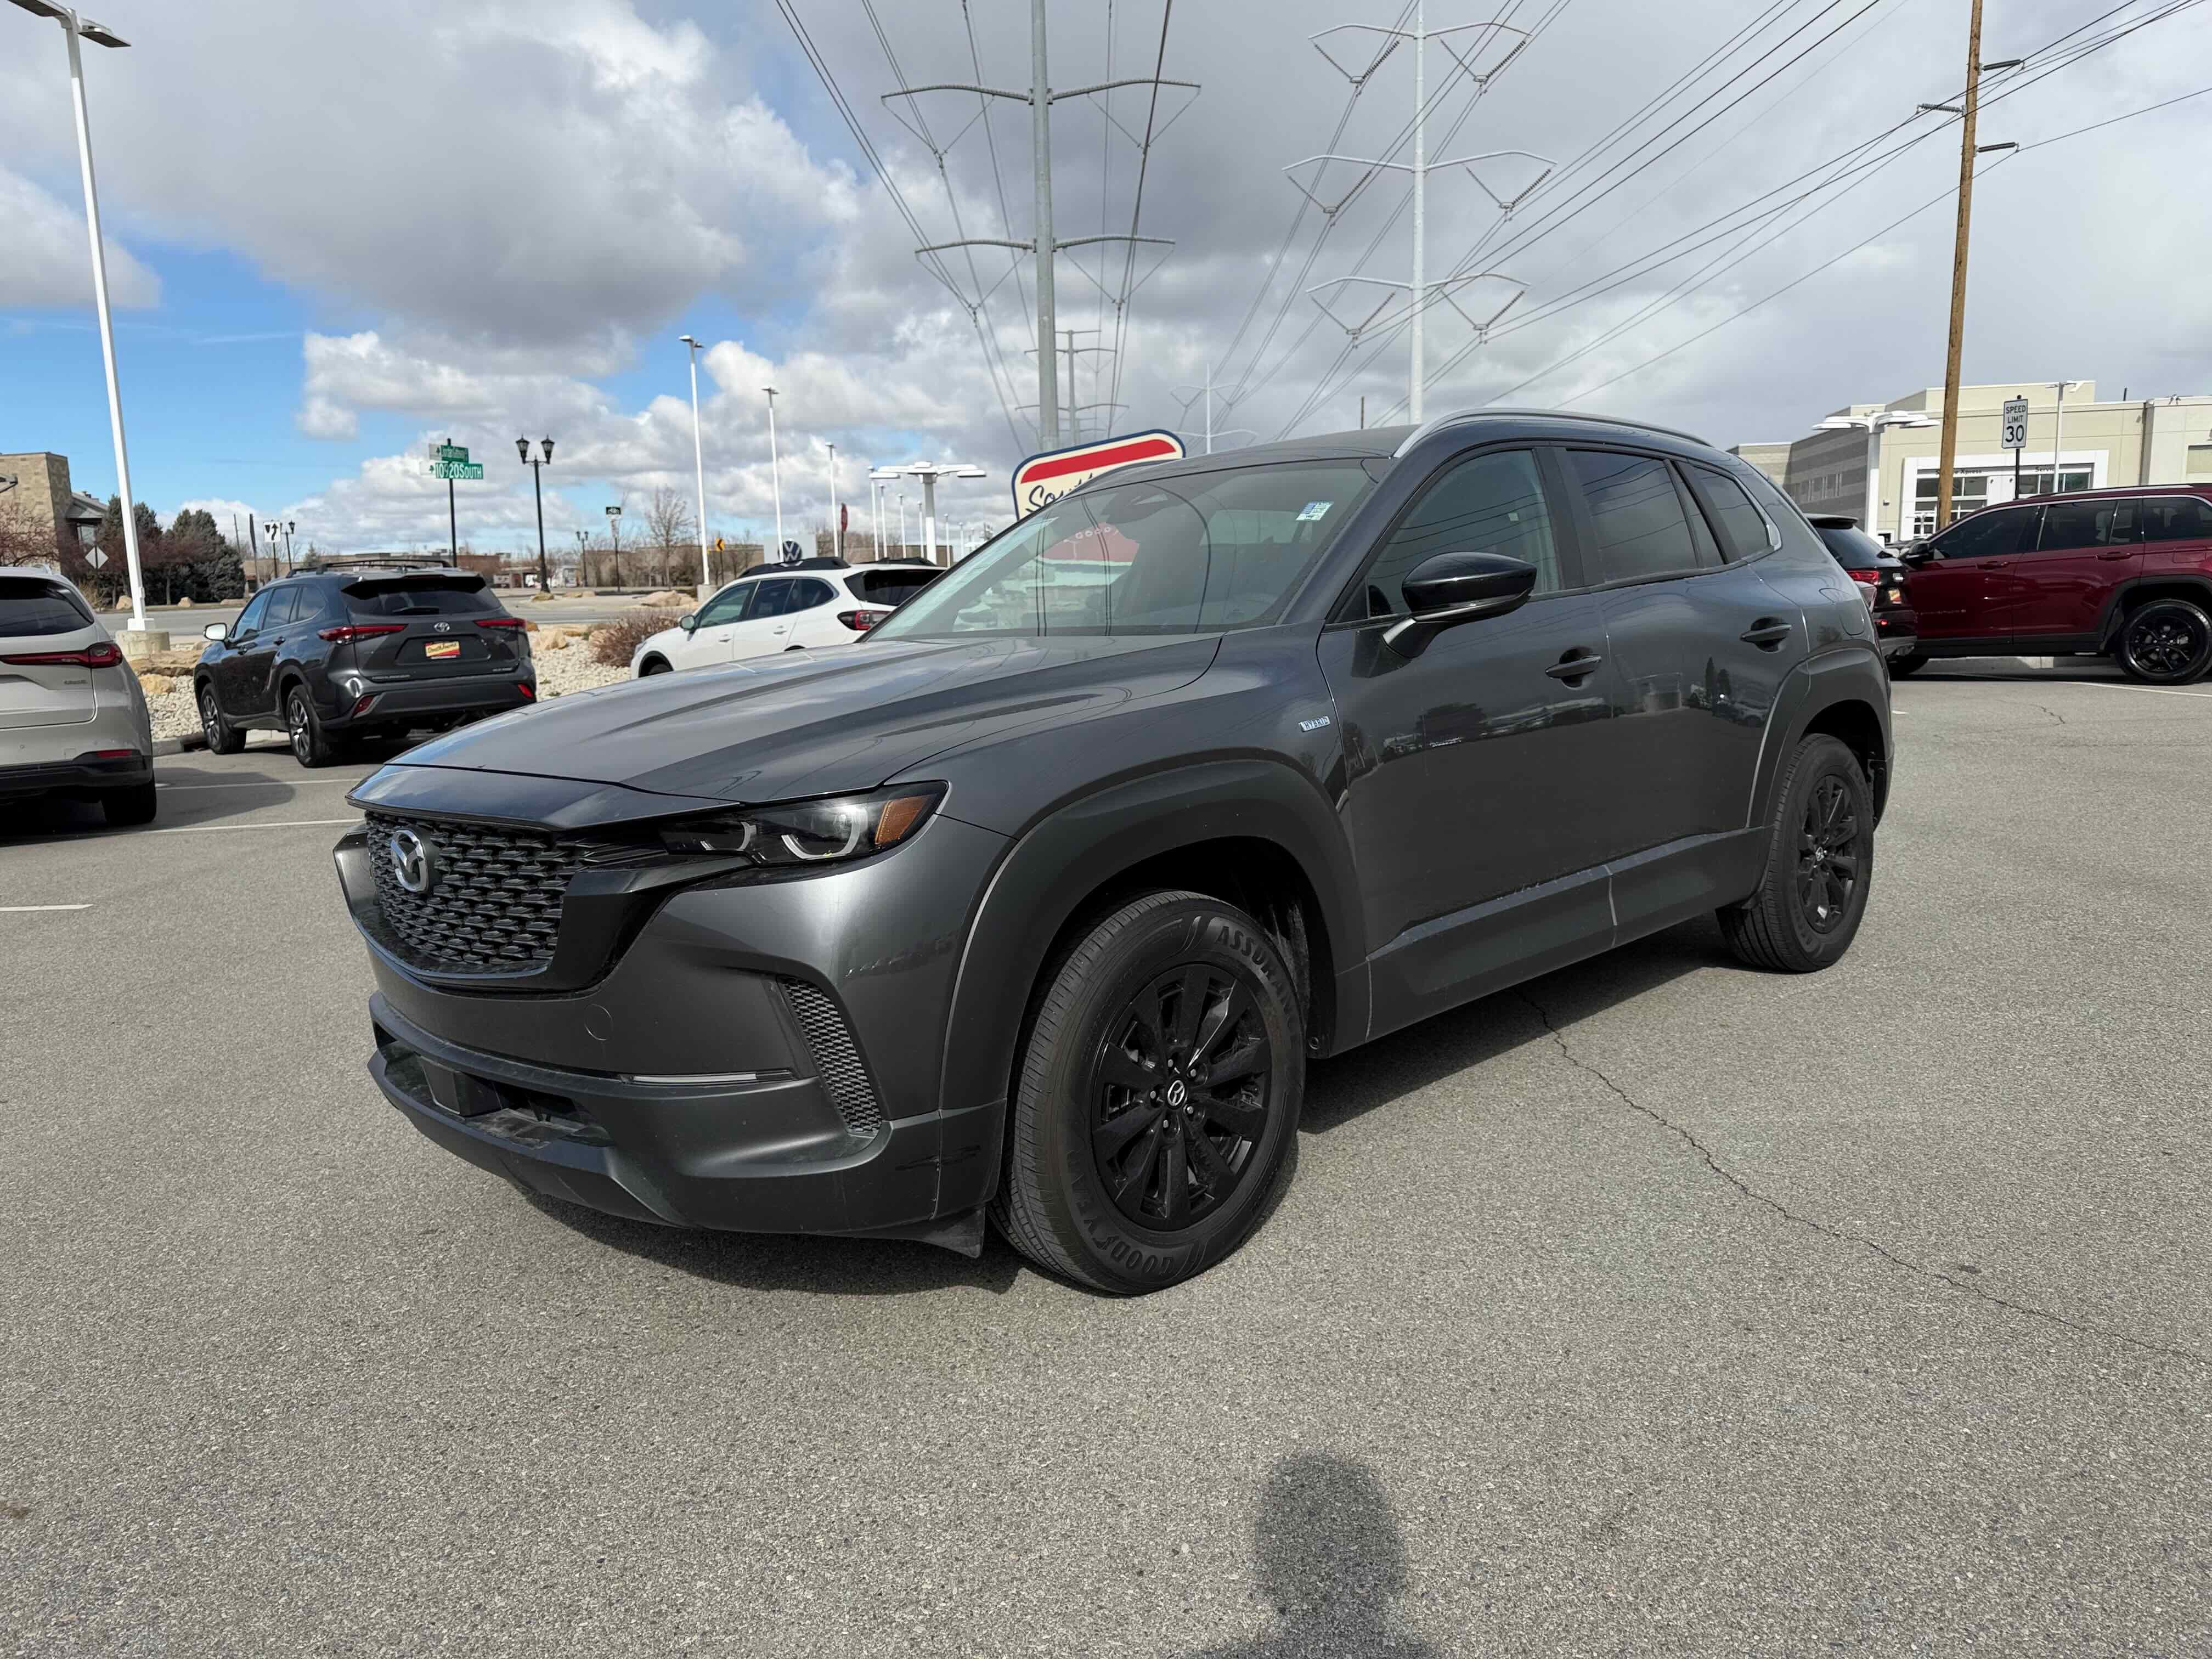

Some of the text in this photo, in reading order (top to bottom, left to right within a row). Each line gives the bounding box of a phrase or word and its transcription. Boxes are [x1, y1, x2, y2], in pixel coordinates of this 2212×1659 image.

[2006, 405, 2026, 414] SPEED
[2007, 415, 2023, 424] LIMIT
[2005, 425, 2024, 443] 30
[1304, 717, 1328, 729] HYBRID
